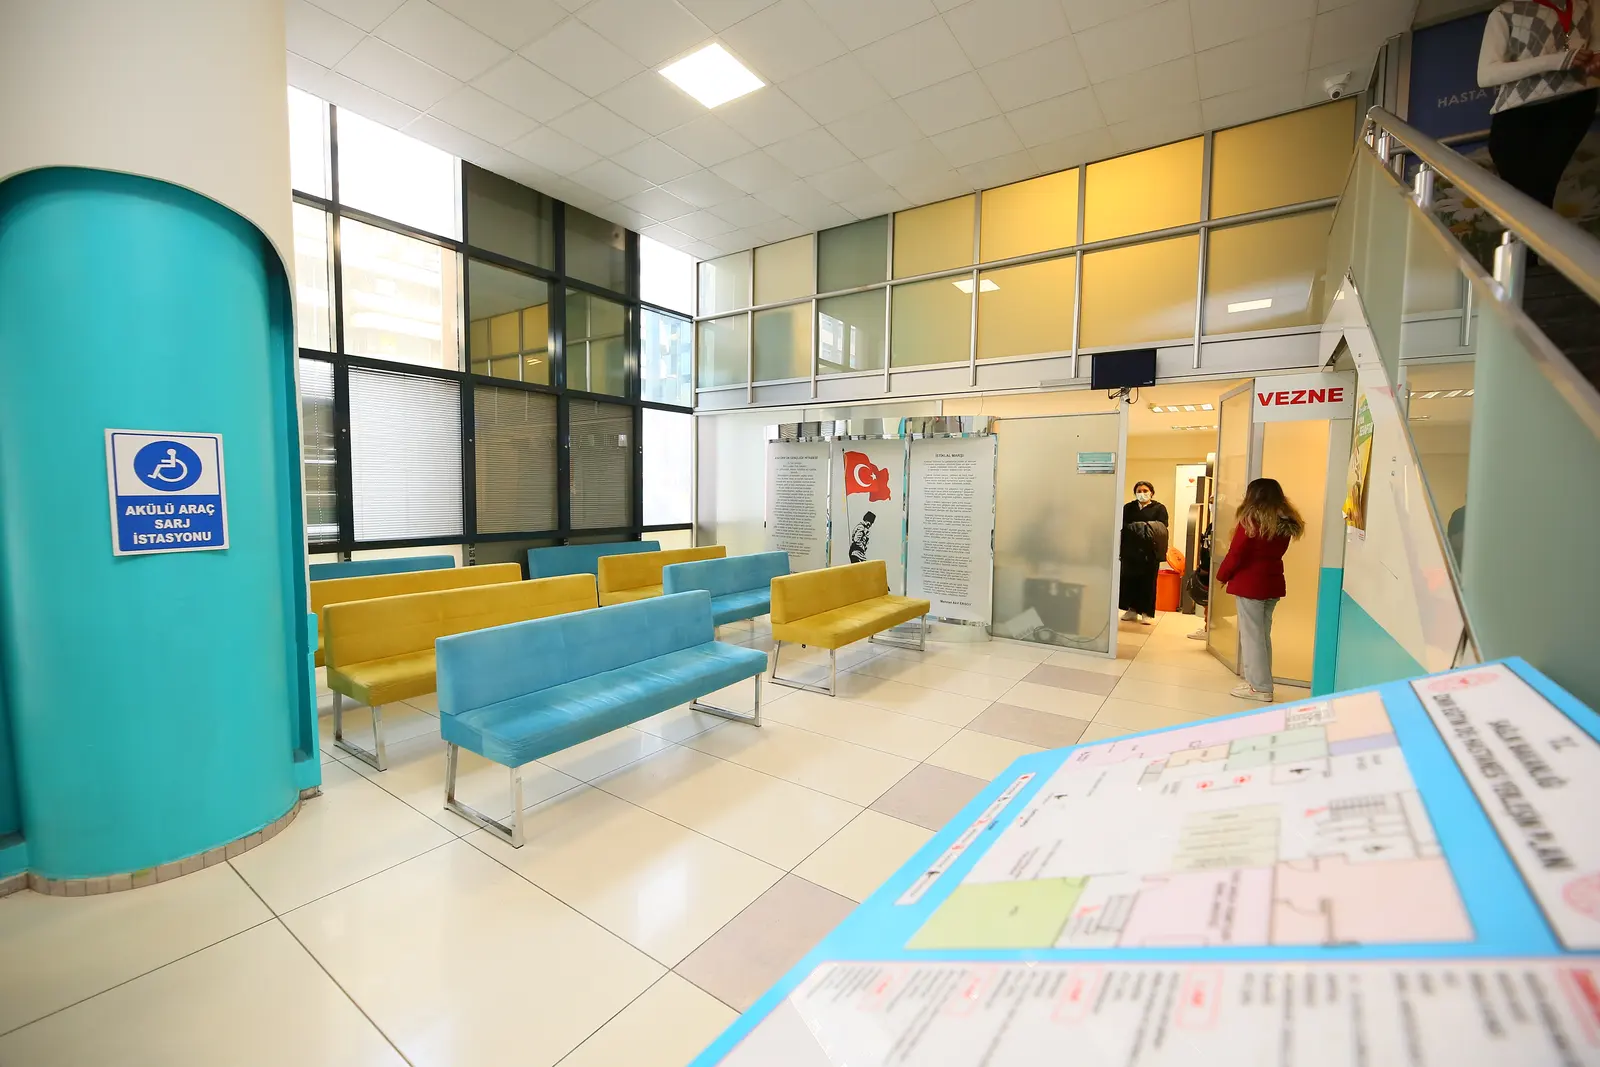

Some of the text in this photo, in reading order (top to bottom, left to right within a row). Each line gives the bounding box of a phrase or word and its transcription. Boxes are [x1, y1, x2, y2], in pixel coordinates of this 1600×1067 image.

[1437, 89, 1488, 108] HASTA
[1257, 387, 1344, 407] VEZNE
[125, 503, 216, 516] AKÜLÜ ARAÇ
[154, 518, 191, 530] SARJ
[133, 531, 212, 545] İSTASYONU
